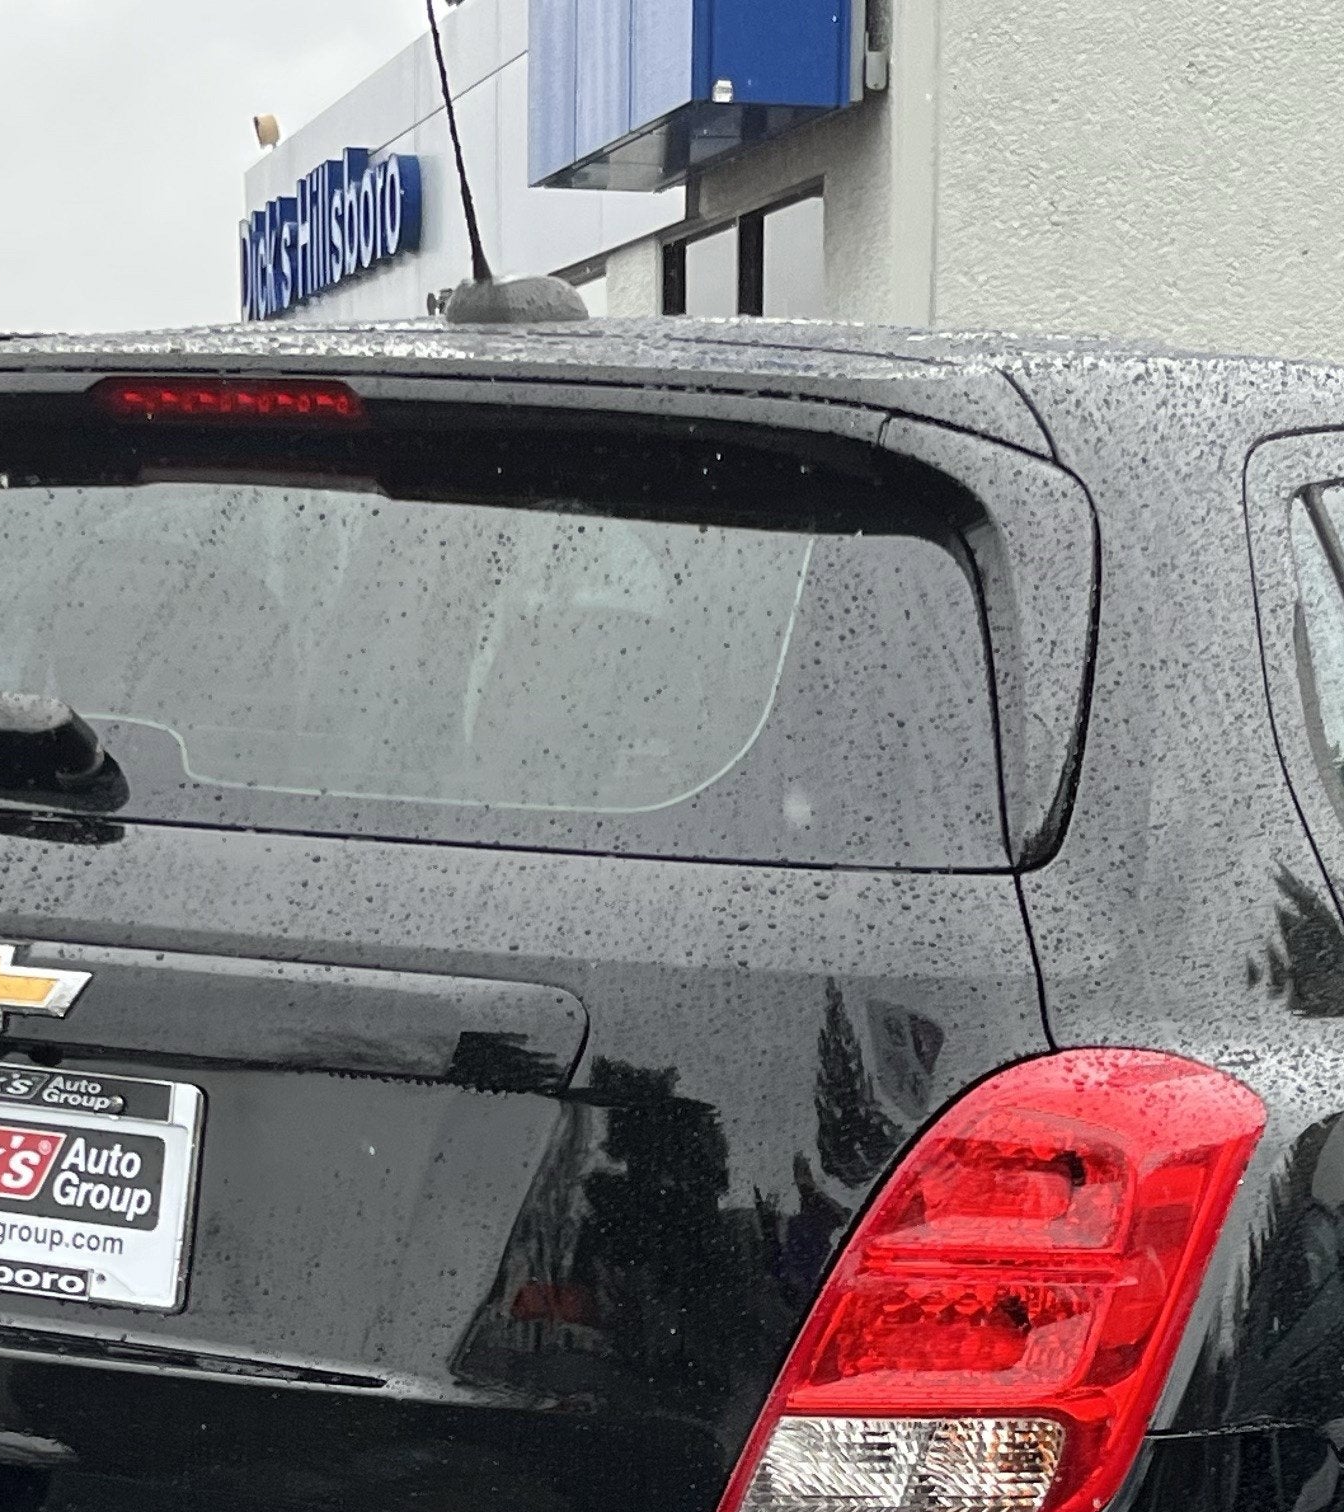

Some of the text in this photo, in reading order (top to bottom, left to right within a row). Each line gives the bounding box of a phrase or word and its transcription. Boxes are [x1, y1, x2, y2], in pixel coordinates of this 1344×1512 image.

[239, 147, 402, 323] Dick's Hillsboro
[41, 1088, 111, 1111] Group
[48, 1075, 102, 1094] Auto
[61, 1137, 142, 1179] Auto
[52, 1171, 152, 1221] Group
